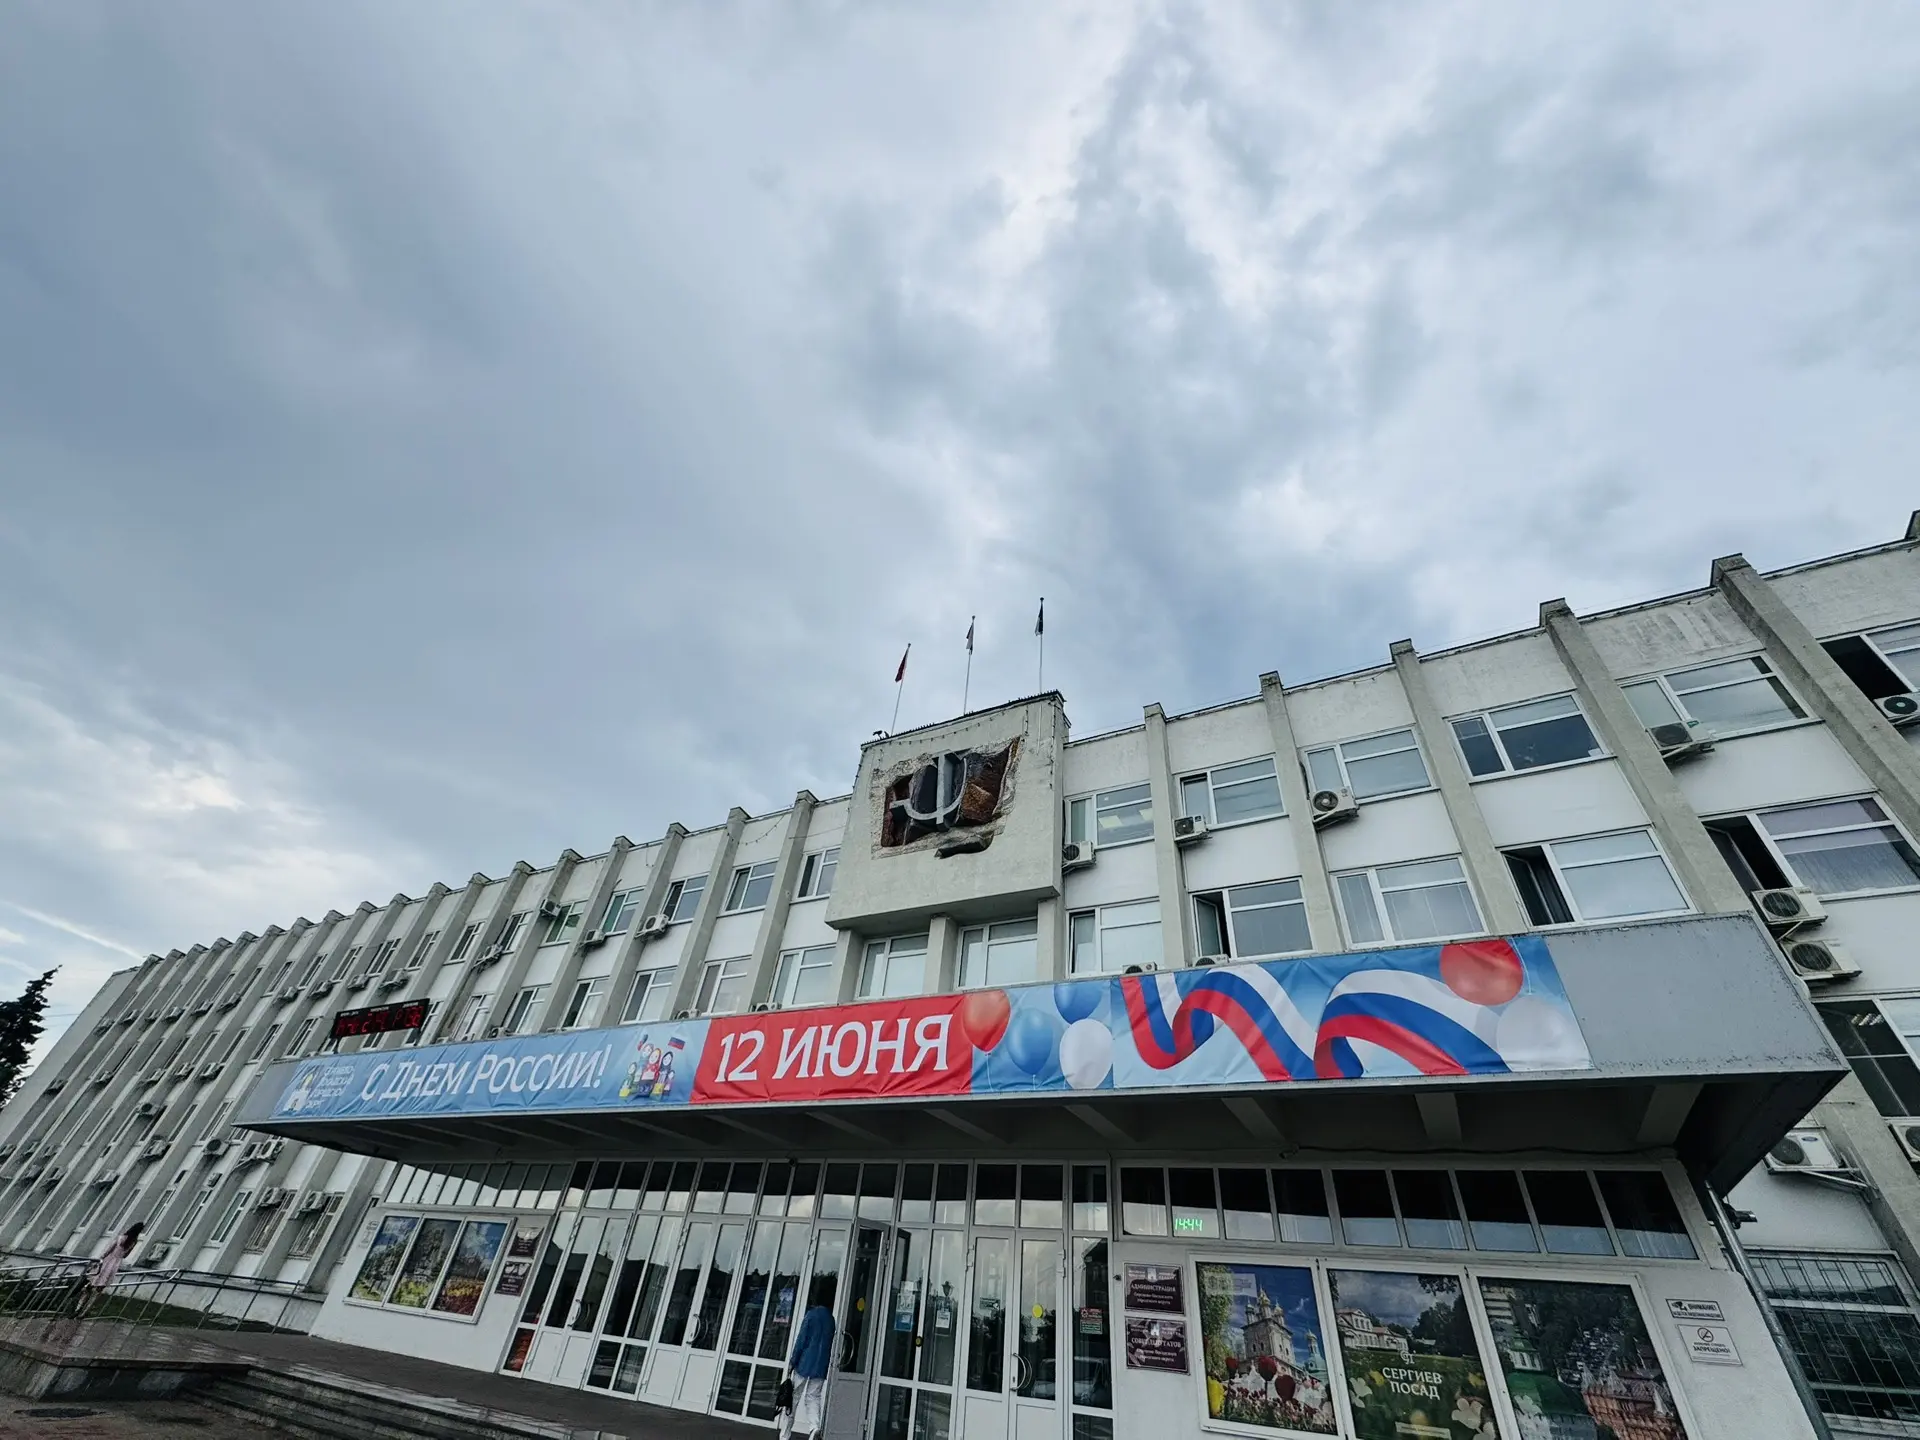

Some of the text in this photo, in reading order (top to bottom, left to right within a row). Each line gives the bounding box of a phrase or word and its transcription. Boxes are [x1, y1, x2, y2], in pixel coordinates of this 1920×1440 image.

[714, 1013, 953, 1083] 12 ИЮНЯ
[361, 1043, 612, 1102] С ДНЕМ РОССИИ!
[1174, 1218, 1203, 1232] 14:44
[1382, 1367, 1443, 1384] СЕРГИЕВ
[1389, 1380, 1441, 1401] ПОСАД
